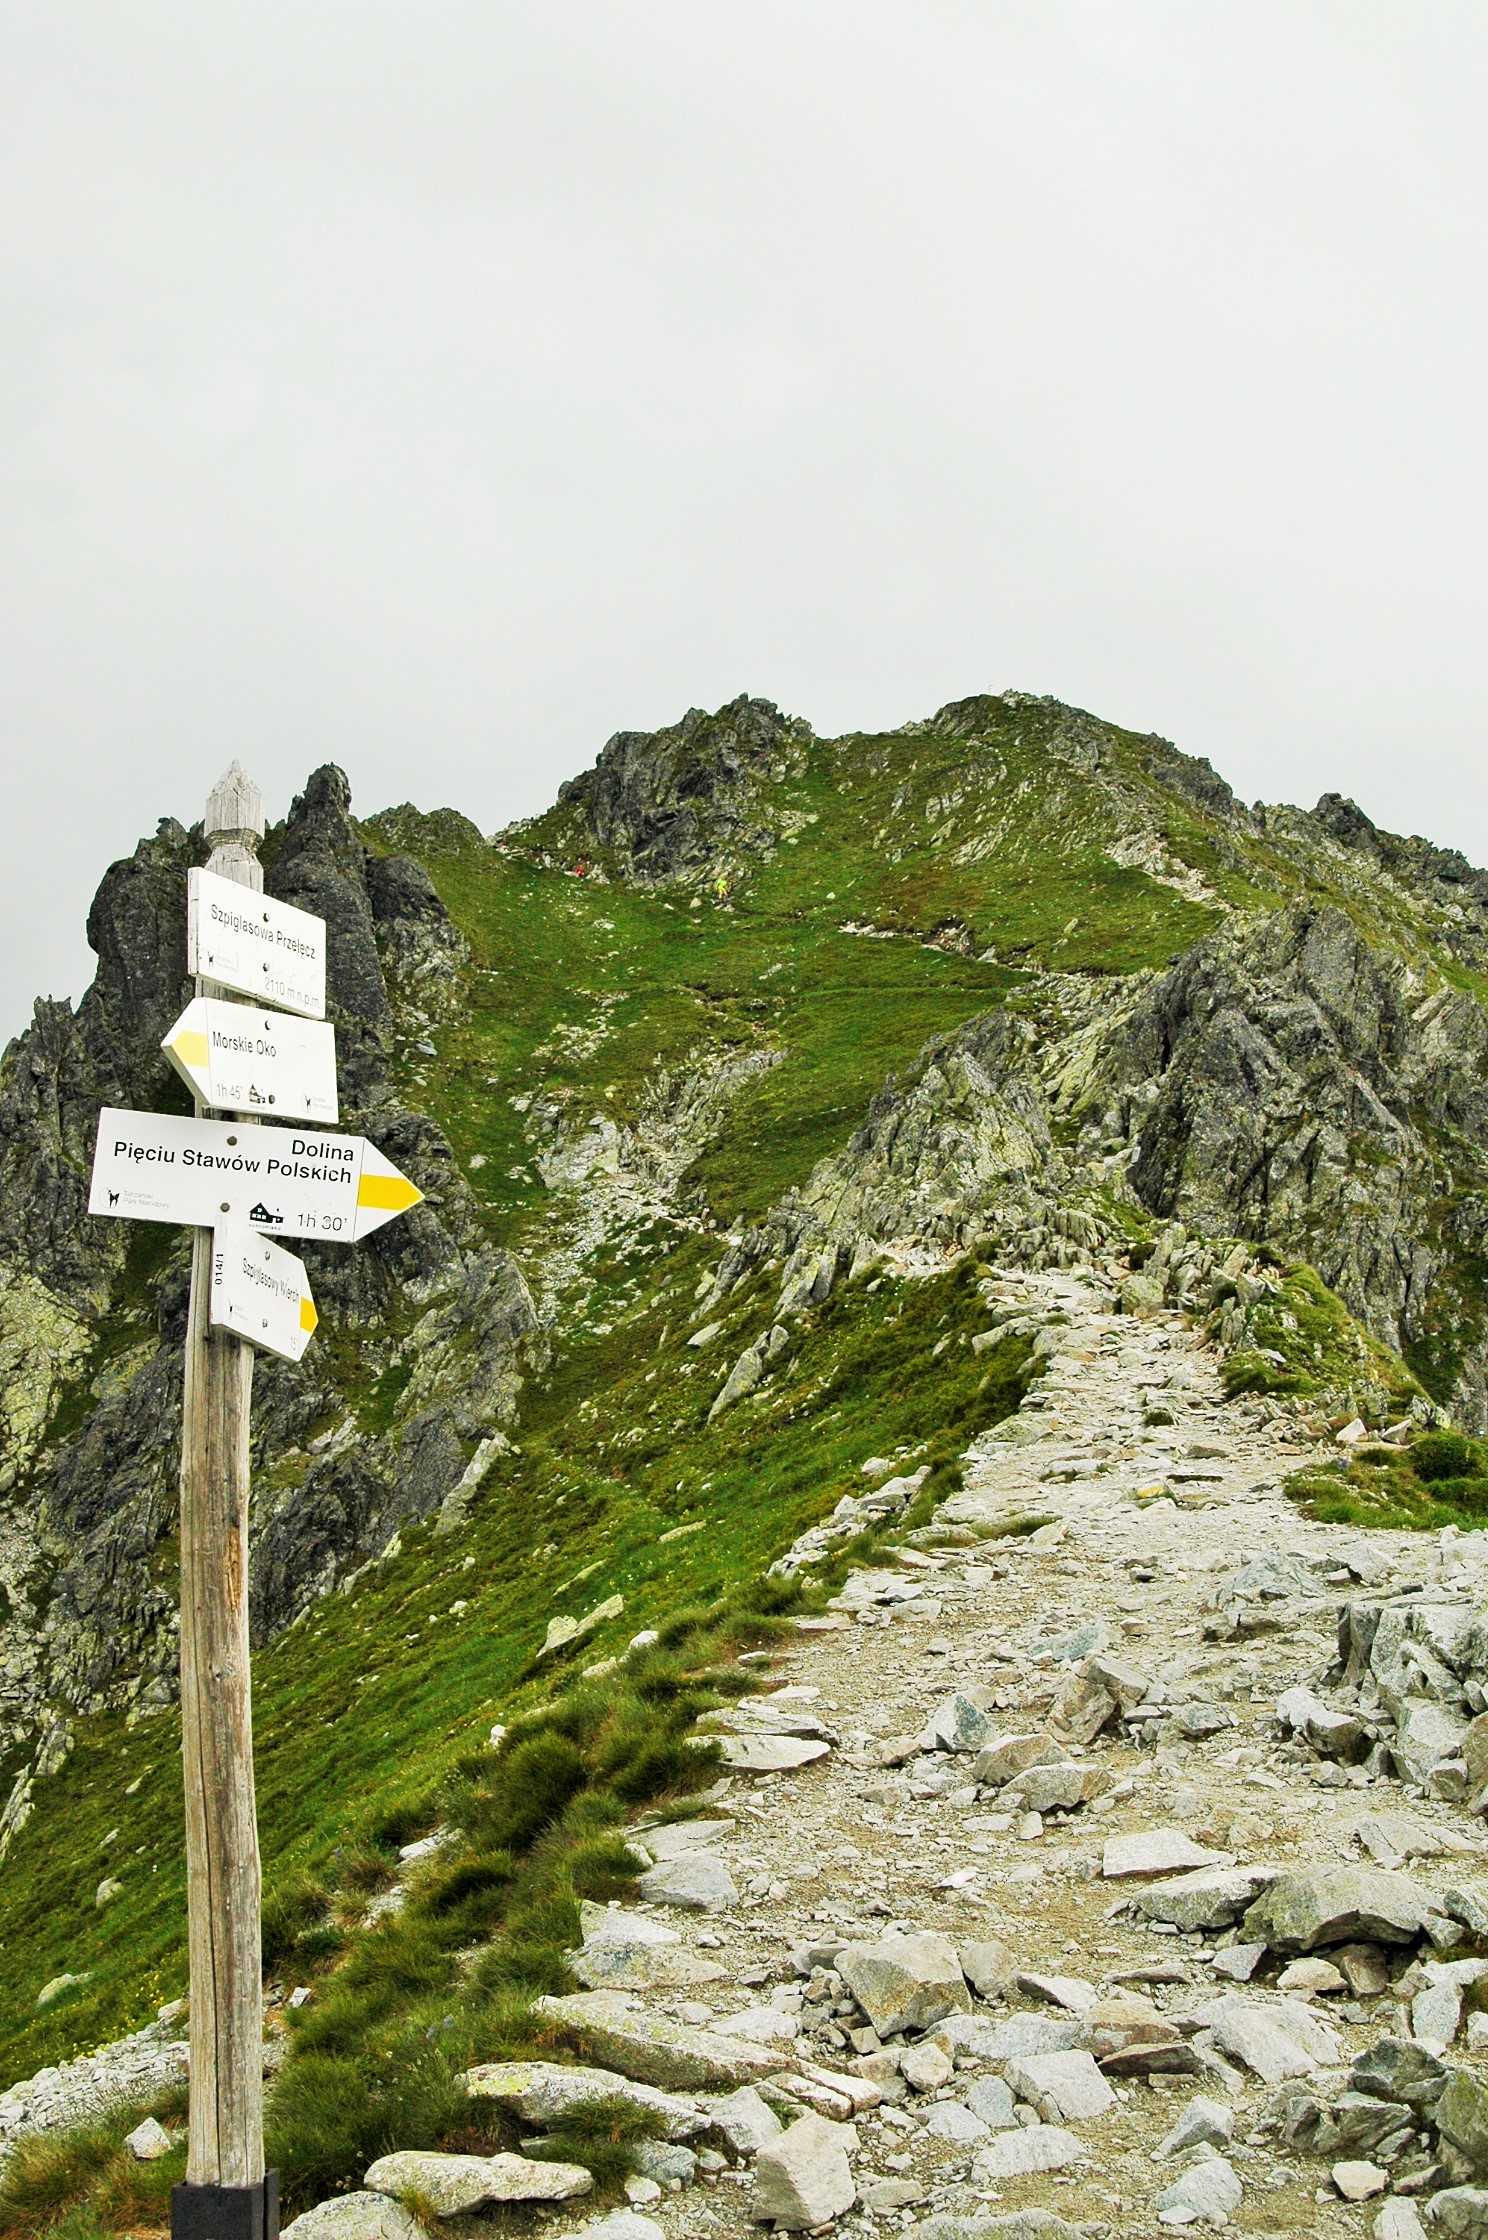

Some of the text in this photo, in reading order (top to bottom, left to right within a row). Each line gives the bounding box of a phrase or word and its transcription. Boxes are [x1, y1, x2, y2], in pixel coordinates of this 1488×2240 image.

[210, 904, 315, 959] Szpiglasowa Przełęcz
[264, 976, 285, 995] 2110
[287, 986, 295, 999] m
[212, 1031, 277, 1057] Morskie Oko
[216, 1083, 227, 1098] 1h
[113, 1141, 352, 1184] Pięciu Stawów Polskich
[291, 1139, 354, 1162] Dolina
[297, 1213, 316, 1229] 1h
[214, 1253, 224, 1285] 014/1
[242, 1257, 279, 1297] Szpiglasowy
